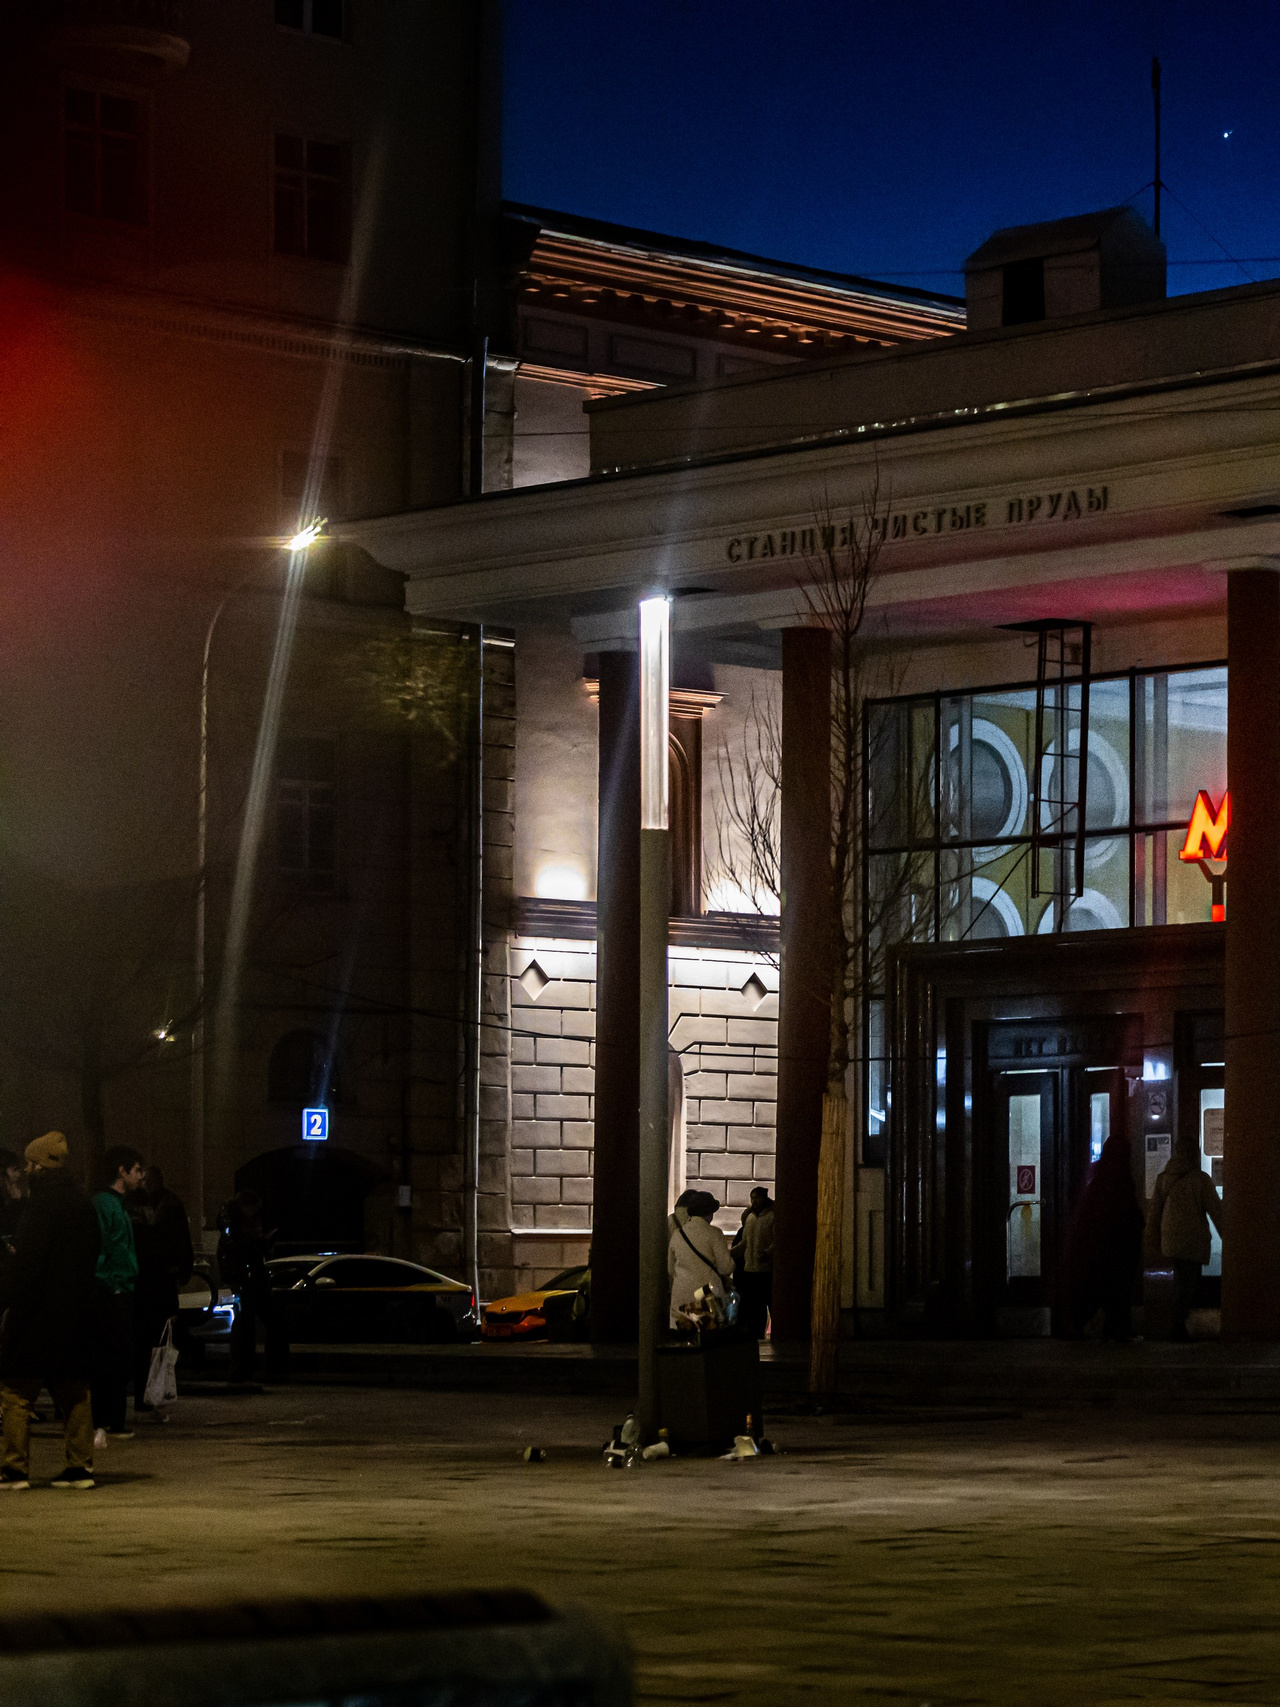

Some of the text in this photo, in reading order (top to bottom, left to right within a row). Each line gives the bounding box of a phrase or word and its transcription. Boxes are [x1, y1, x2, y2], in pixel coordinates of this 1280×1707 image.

[727, 486, 1108, 563] СТАНЦИЯ ЧИСТЫЕ ПРУДЫ
[310, 1114, 322, 1136] 2
